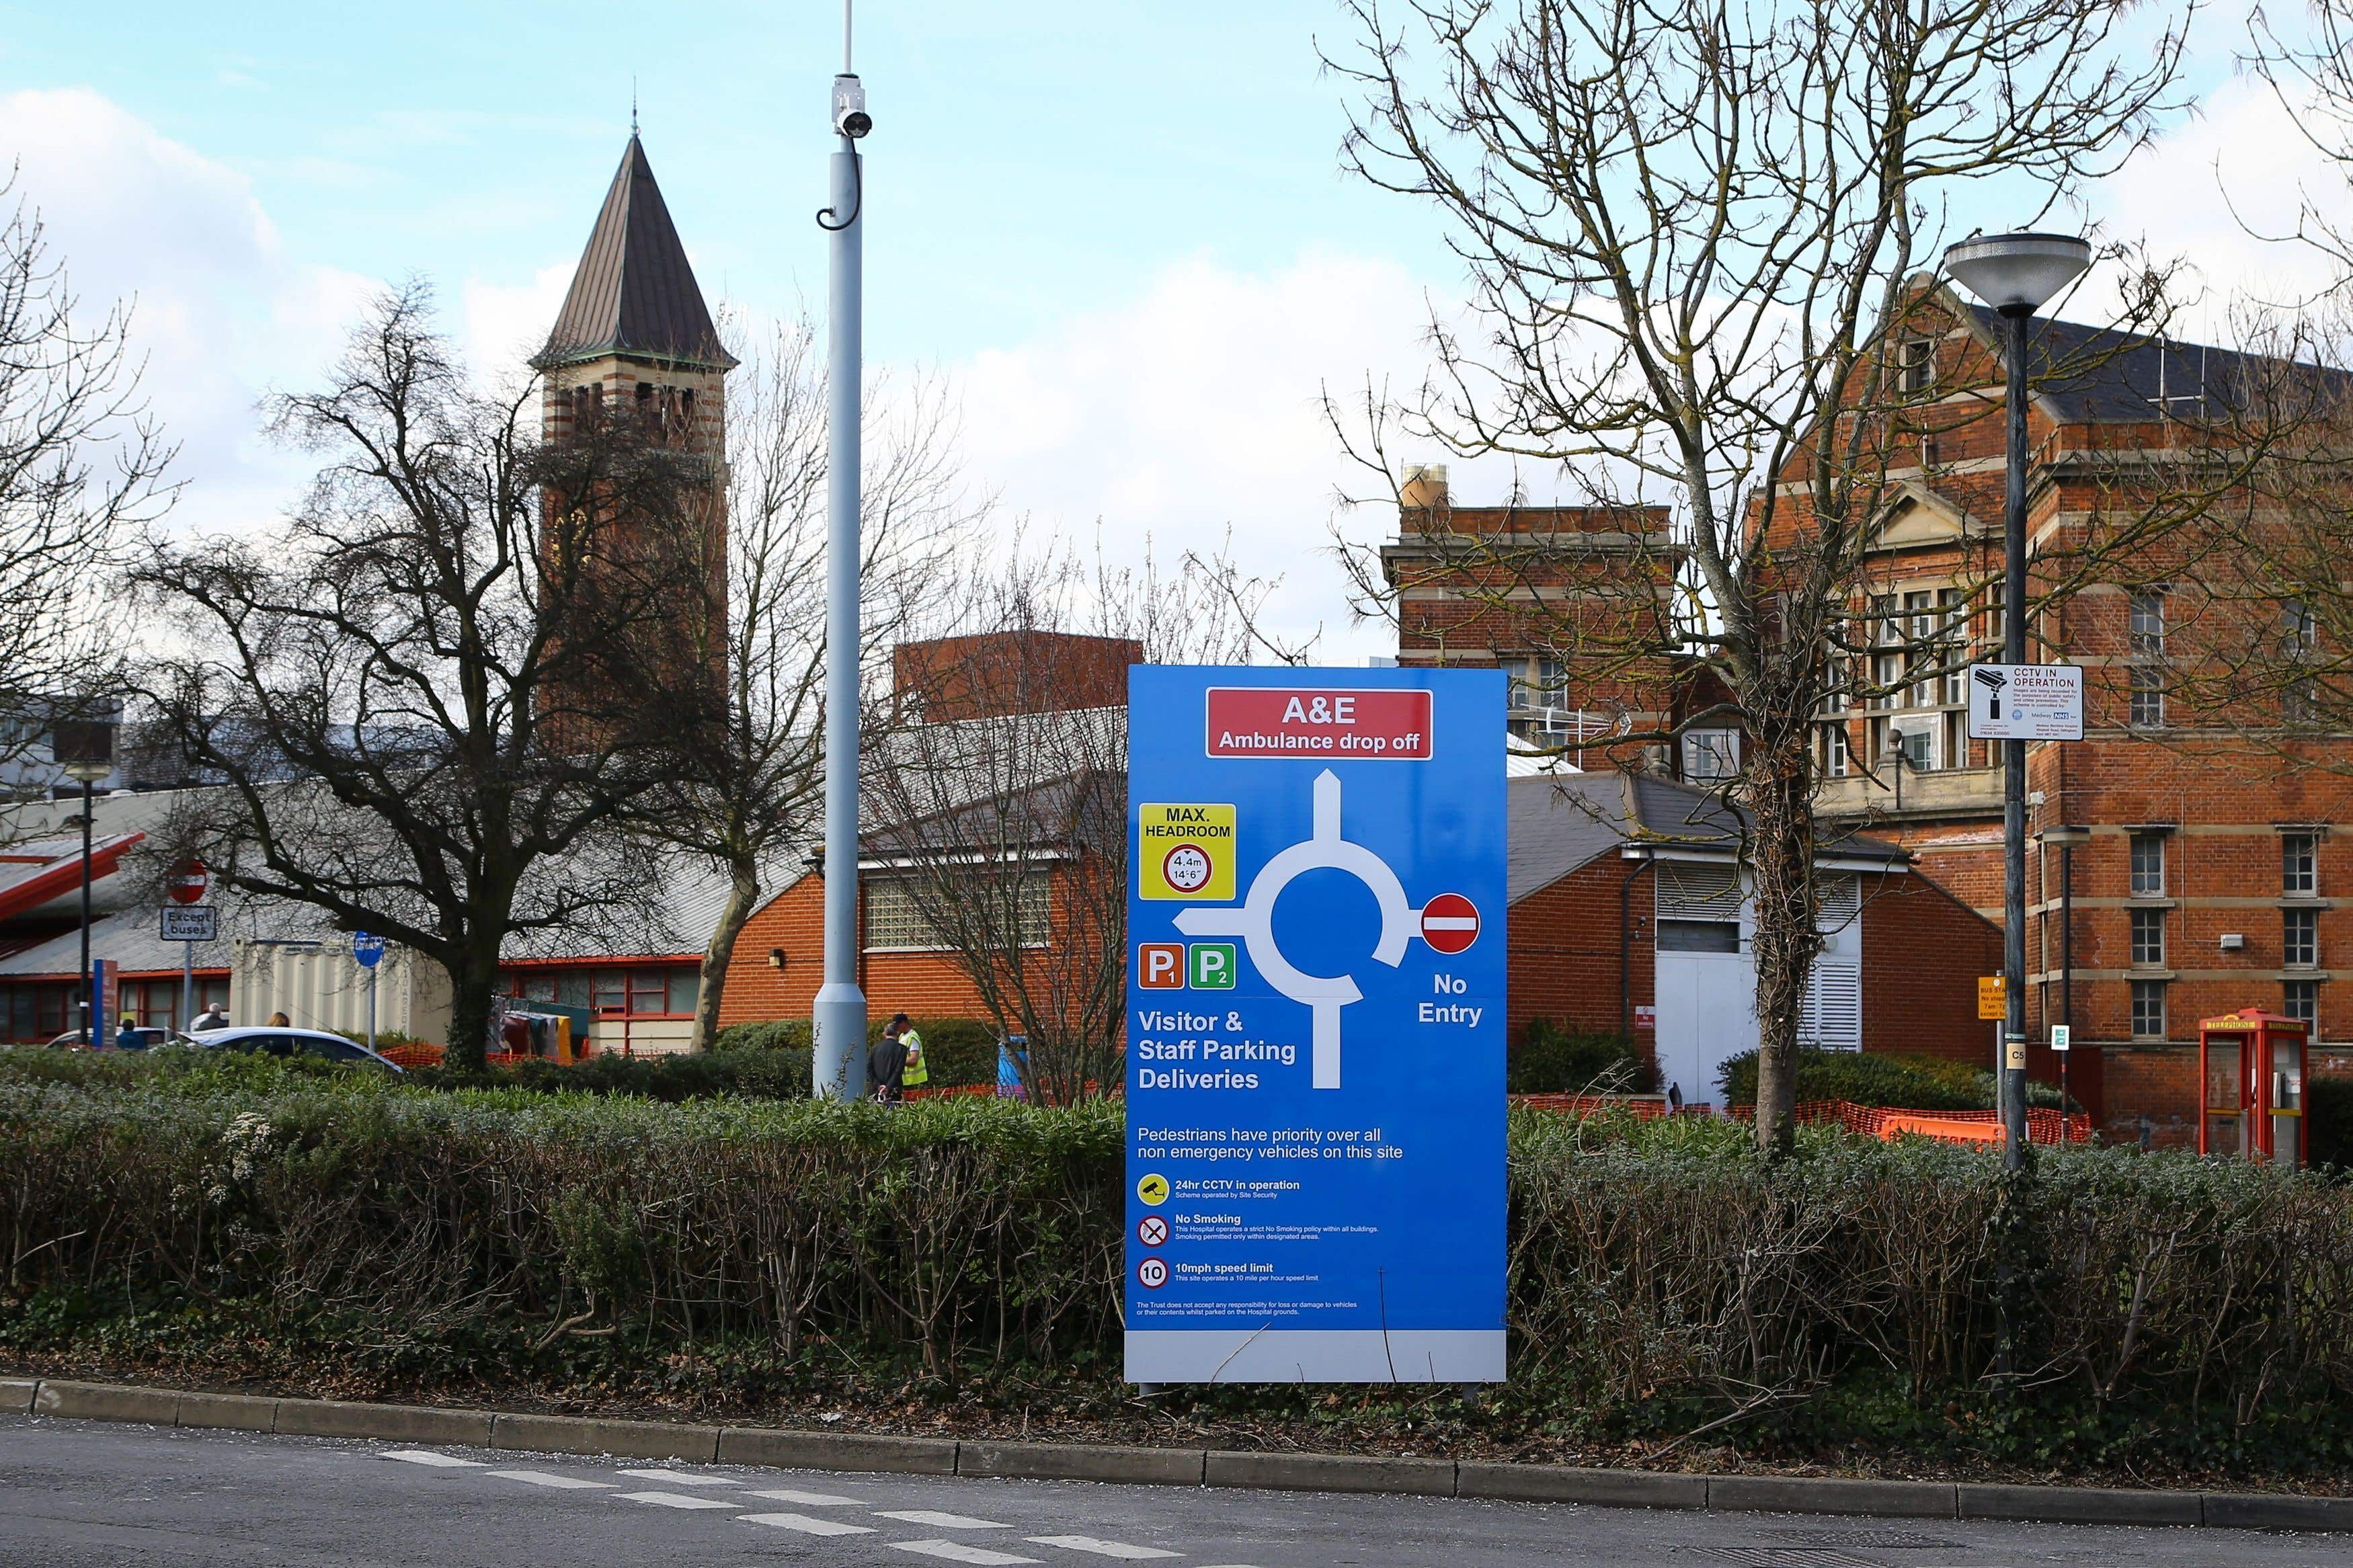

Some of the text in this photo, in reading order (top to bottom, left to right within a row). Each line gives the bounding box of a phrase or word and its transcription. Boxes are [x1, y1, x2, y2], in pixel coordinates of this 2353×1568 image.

[2014, 668, 2057, 677] CCTV IN
[2014, 678, 2074, 687] OPERATION
[1281, 696, 1356, 724] A&E
[1219, 731, 1421, 753] Ambulance drop off
[1166, 807, 1210, 822] MAX.
[1146, 825, 1230, 837] HEADROOM
[1174, 856, 1201, 866] 4.4m
[168, 912, 210, 923] Except
[171, 925, 206, 934] buses
[1149, 950, 1174, 983] P1
[1200, 950, 1227, 983] P2
[1434, 974, 1467, 994] No
[1138, 1011, 1243, 1032] Visitor &
[1419, 1002, 1482, 1028] Entry
[1138, 1039, 1295, 1065] Staff Parking
[2012, 1051, 2024, 1059] C5
[1139, 1068, 1259, 1089] Deliveries
[1138, 1127, 1380, 1145] Pedestrians have priority over all
[1138, 1144, 1403, 1161] non emergency vehicles on this site
[1175, 1180, 1300, 1192] 24hr CCTV in operation
[1175, 1214, 1241, 1226] No Smoking
[1142, 1264, 1162, 1280] 10
[1175, 1263, 1273, 1275] 10mph speed limit
